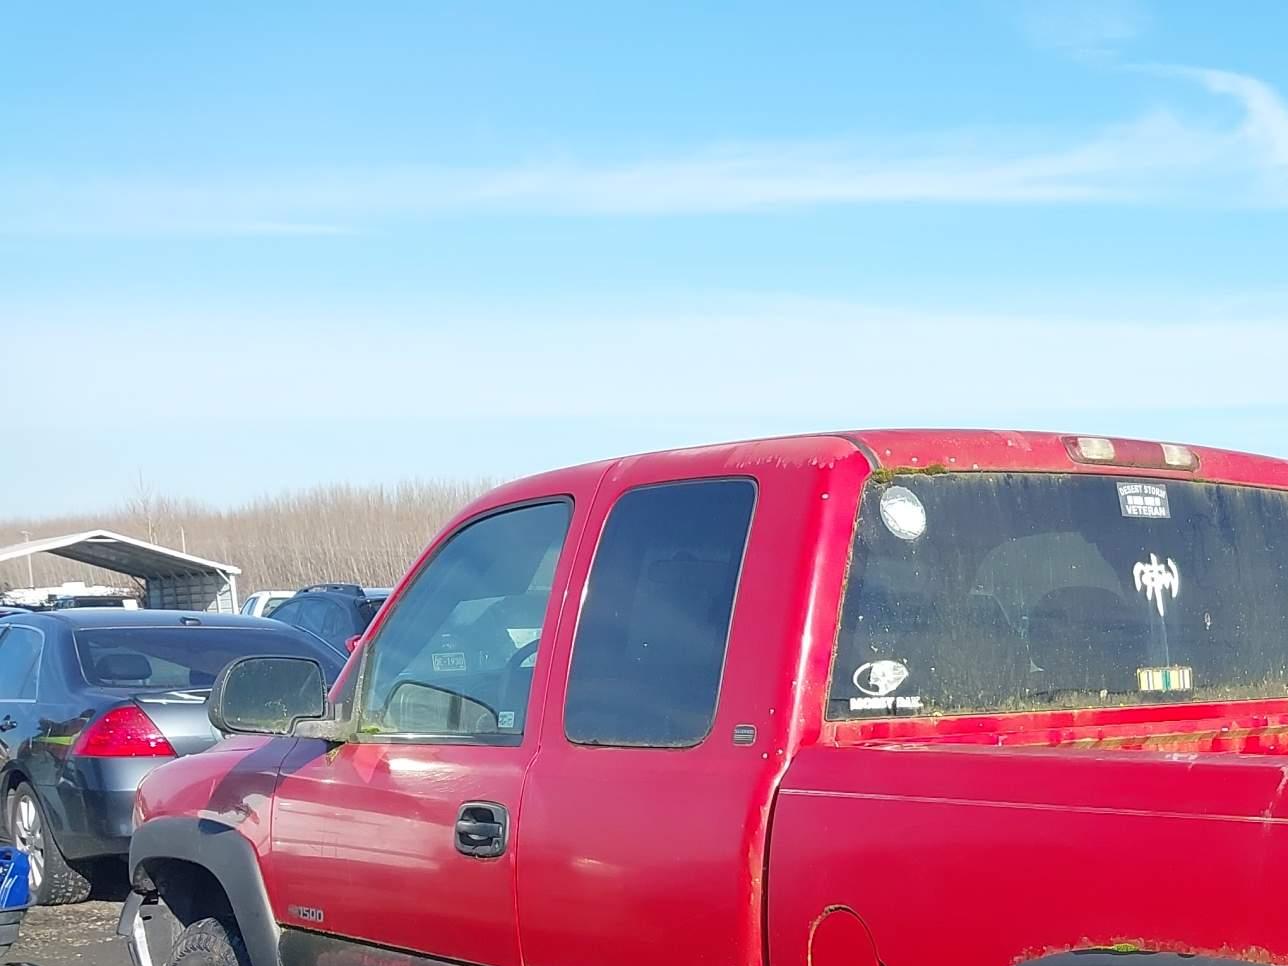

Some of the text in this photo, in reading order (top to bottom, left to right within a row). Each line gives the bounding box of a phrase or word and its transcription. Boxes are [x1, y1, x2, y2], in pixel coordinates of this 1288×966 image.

[1119, 485, 1167, 499] DESERT STORM
[1126, 505, 1167, 516] VETERAN
